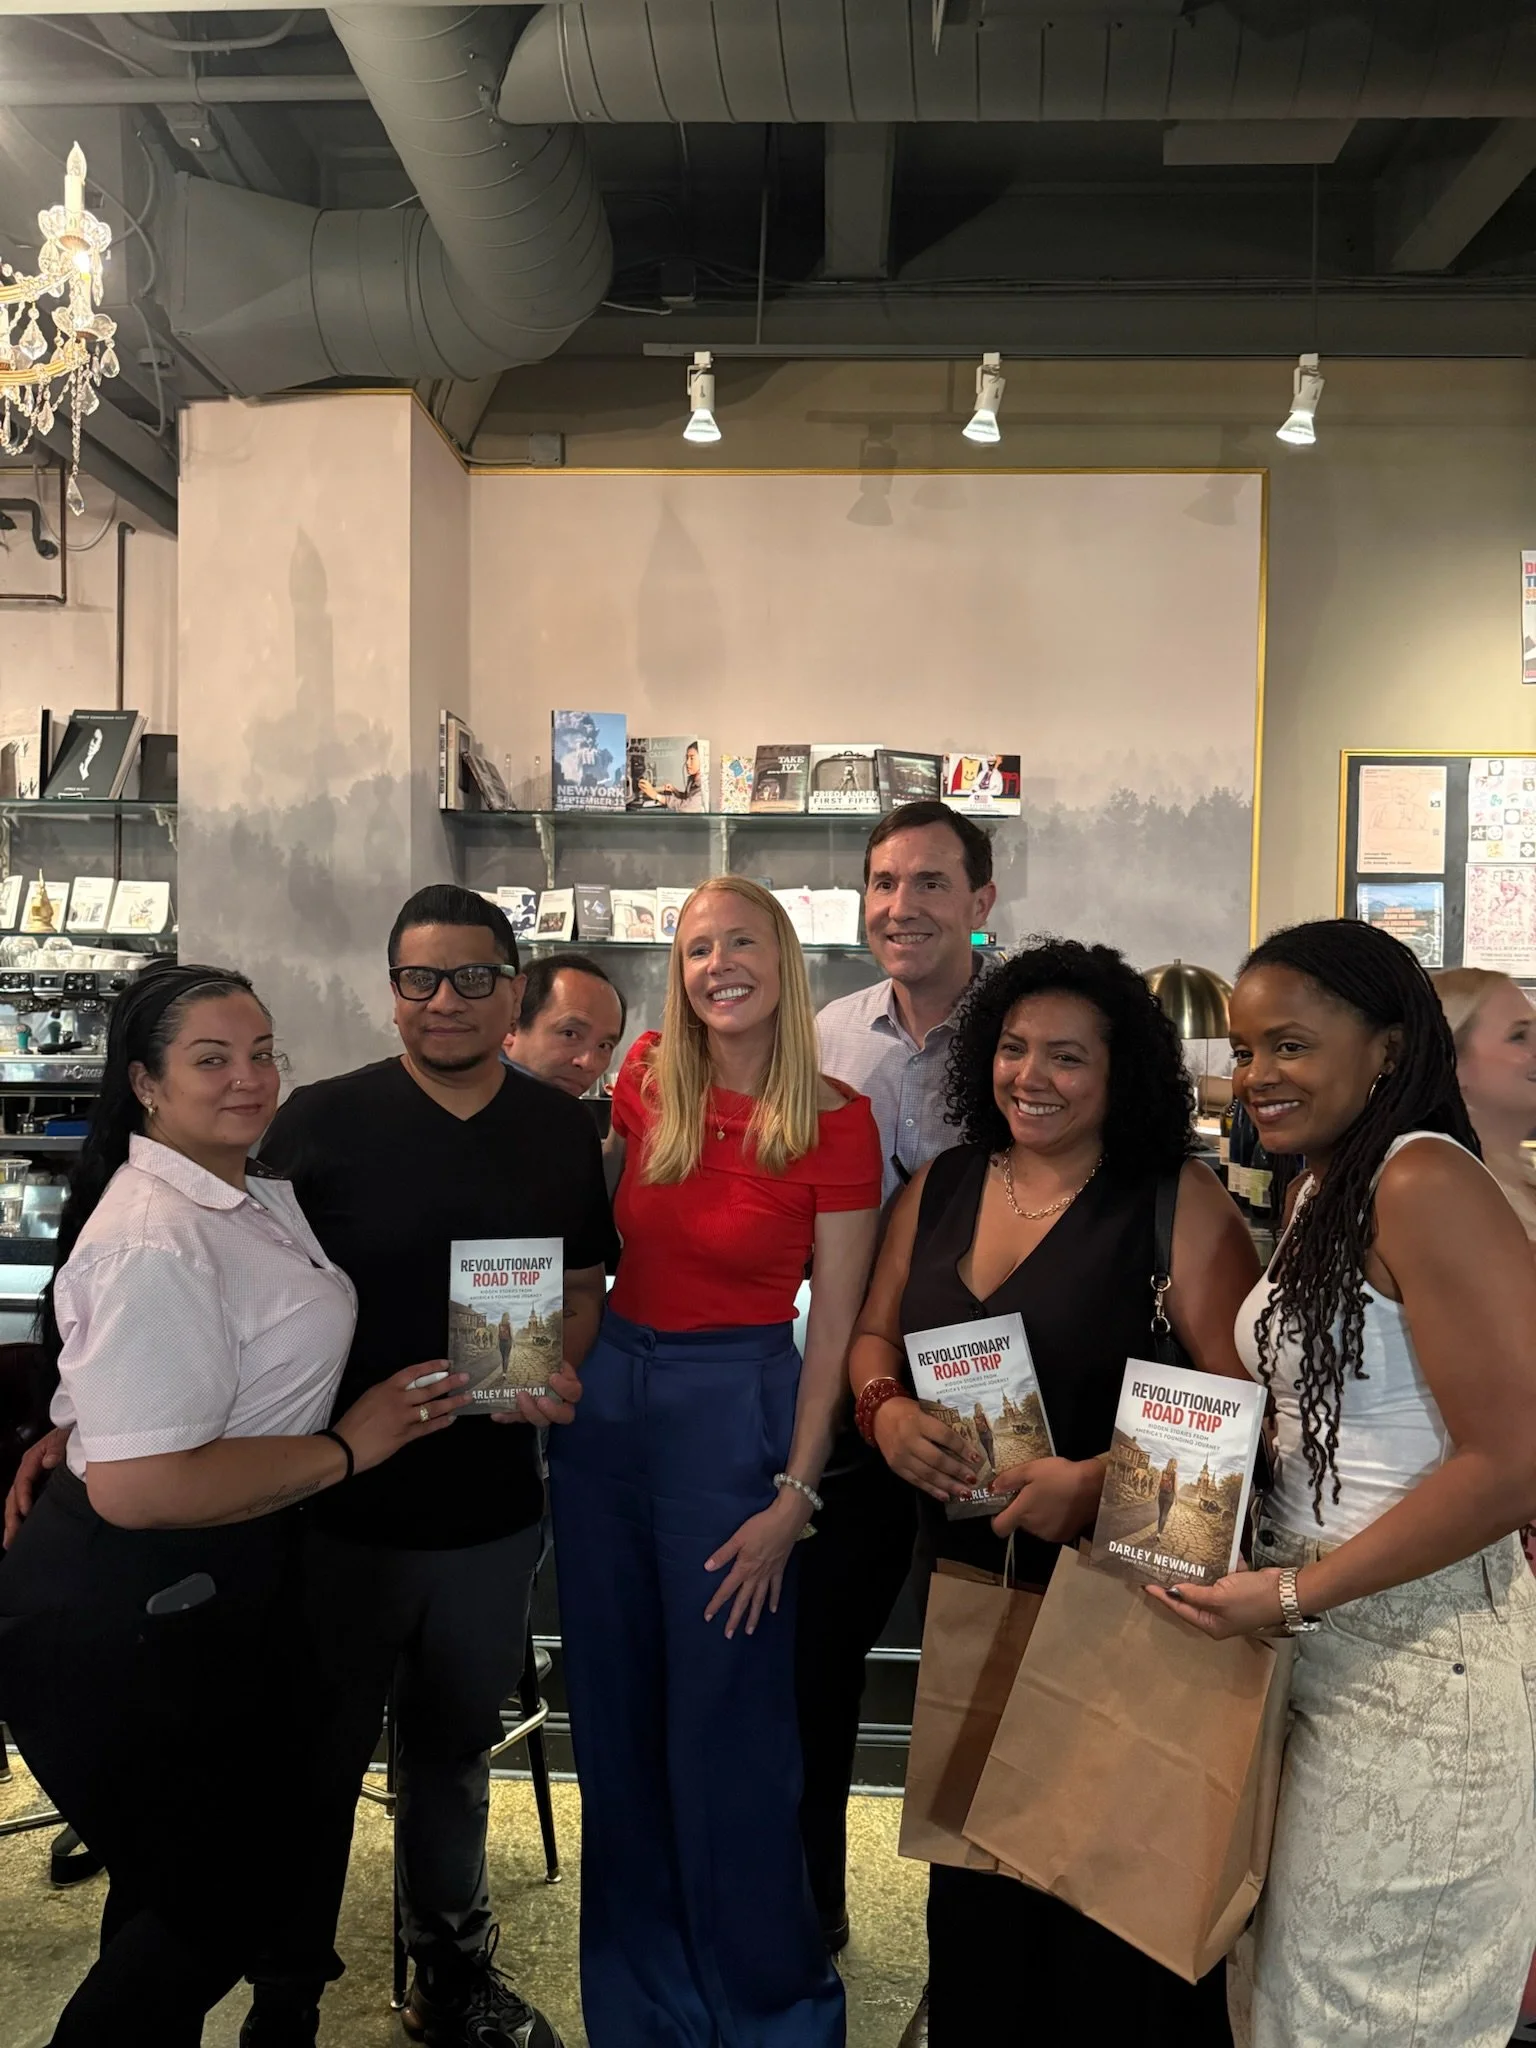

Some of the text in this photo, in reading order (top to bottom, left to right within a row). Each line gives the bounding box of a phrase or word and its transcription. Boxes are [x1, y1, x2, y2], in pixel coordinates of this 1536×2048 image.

[778, 756, 805, 764] TAKE
[781, 763, 800, 771] IVY
[557, 784, 625, 798] NEW YORK
[556, 796, 612, 805] SEPTEMBER
[460, 1257, 553, 1272] REVOLUTIONARY
[473, 1271, 540, 1287] ROAD TRIP
[918, 1336, 1010, 1366] REVOLUTIONARY
[933, 1353, 1002, 1381] ROAD TRIP
[472, 1389, 501, 1399] ARLEY
[1131, 1381, 1241, 1418] REVOLUTIONARY
[1142, 1400, 1222, 1433] ROAD TRIP
[1135, 1428, 1221, 1450] AMERICA'S FOUNDING JOURNEY
[1148, 1423, 1209, 1441] HIDDEN STORIES FROM
[1108, 1541, 1206, 1577] DARLEY NEWMAN
